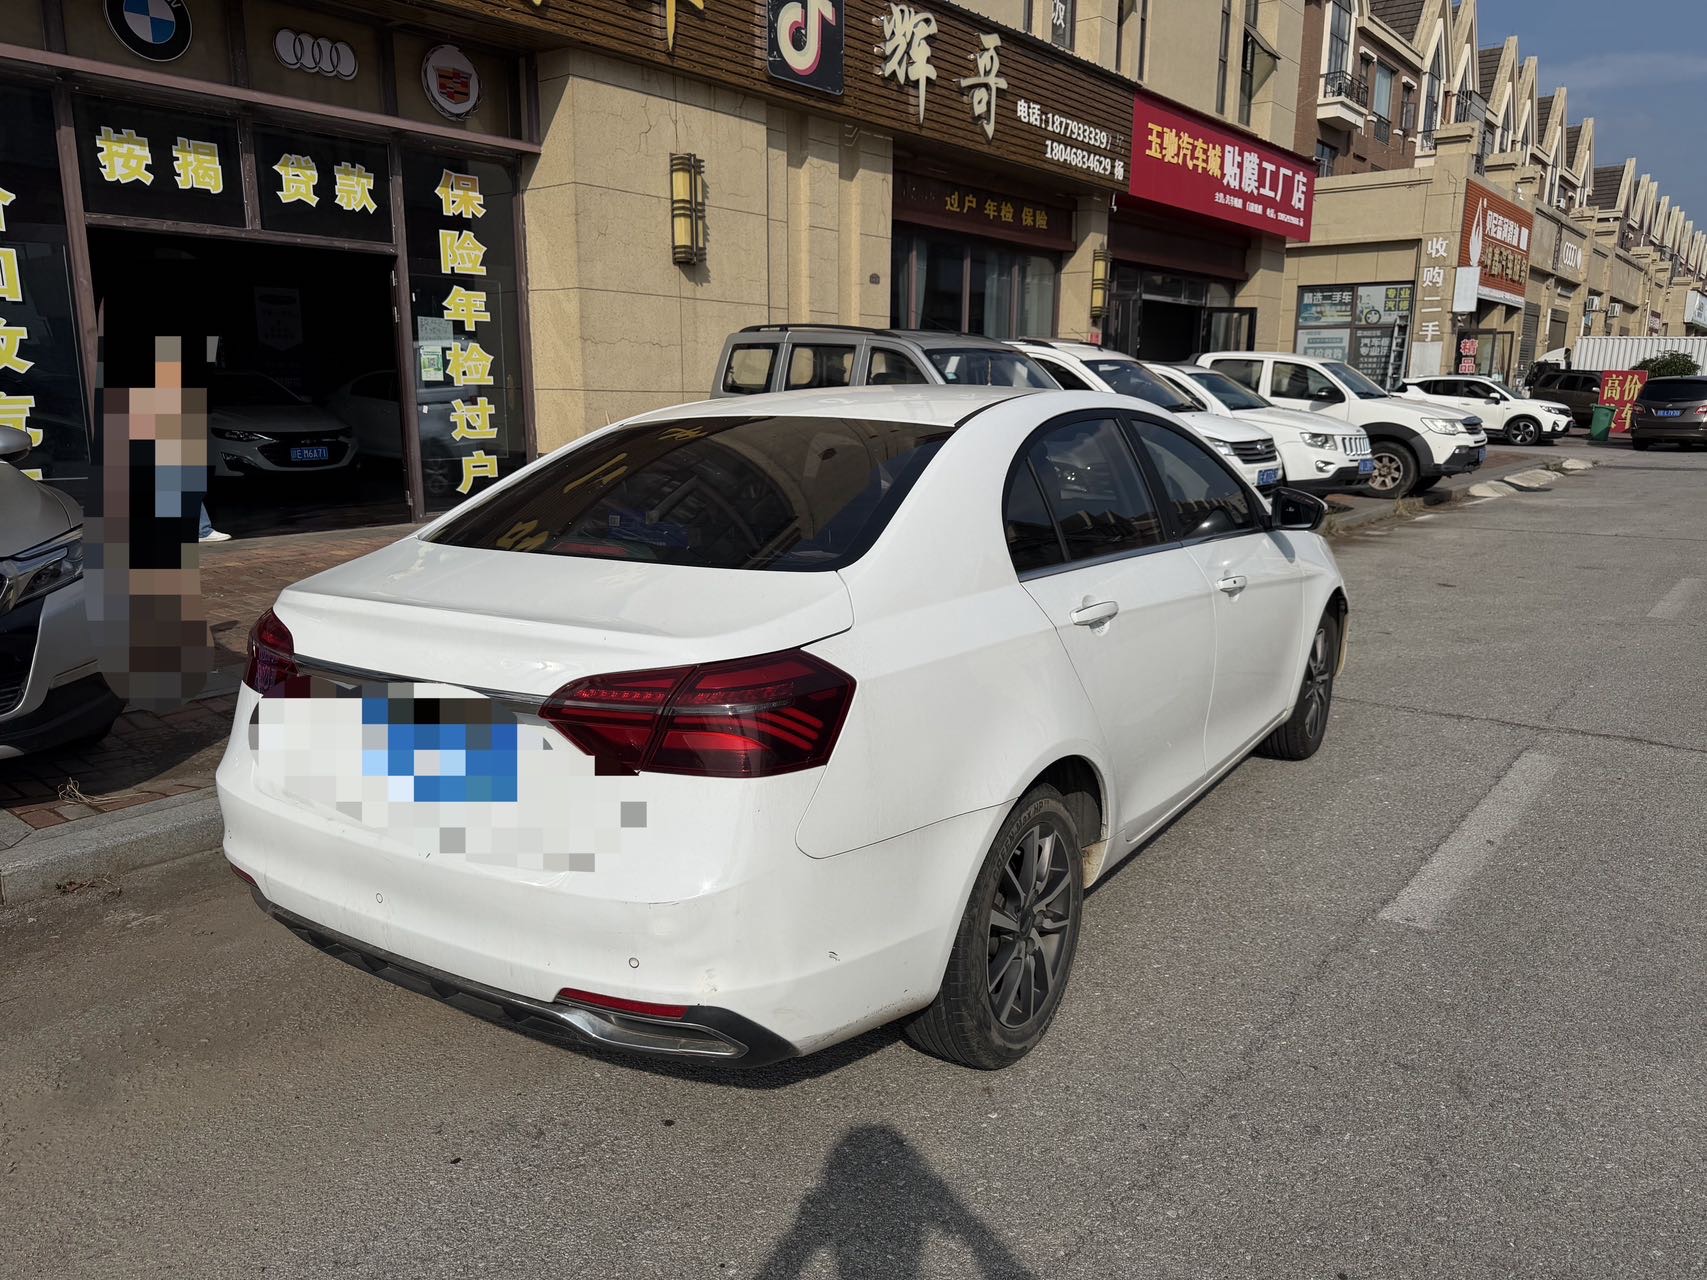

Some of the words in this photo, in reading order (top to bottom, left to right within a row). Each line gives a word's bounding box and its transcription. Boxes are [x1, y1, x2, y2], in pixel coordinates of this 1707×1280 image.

[882, 2, 1008, 142] 辉哥
[96, 126, 377, 214] 按揭贷款
[1045, 140, 1111, 175] 18046834629
[1223, 144, 1308, 211] 贴膜工厂店
[945, 192, 977, 213] 过户
[984, 199, 1014, 223] 年检
[1021, 206, 1048, 230] 保险
[1303, 291, 1352, 304] 精选二手车
[1386, 287, 1411, 299] 专业
[1419, 237, 1449, 342] 收购二手
[435, 168, 499, 495] 保险年检过户
[1458, 338, 1478, 374] 精品
[1603, 374, 1644, 401] 高价
